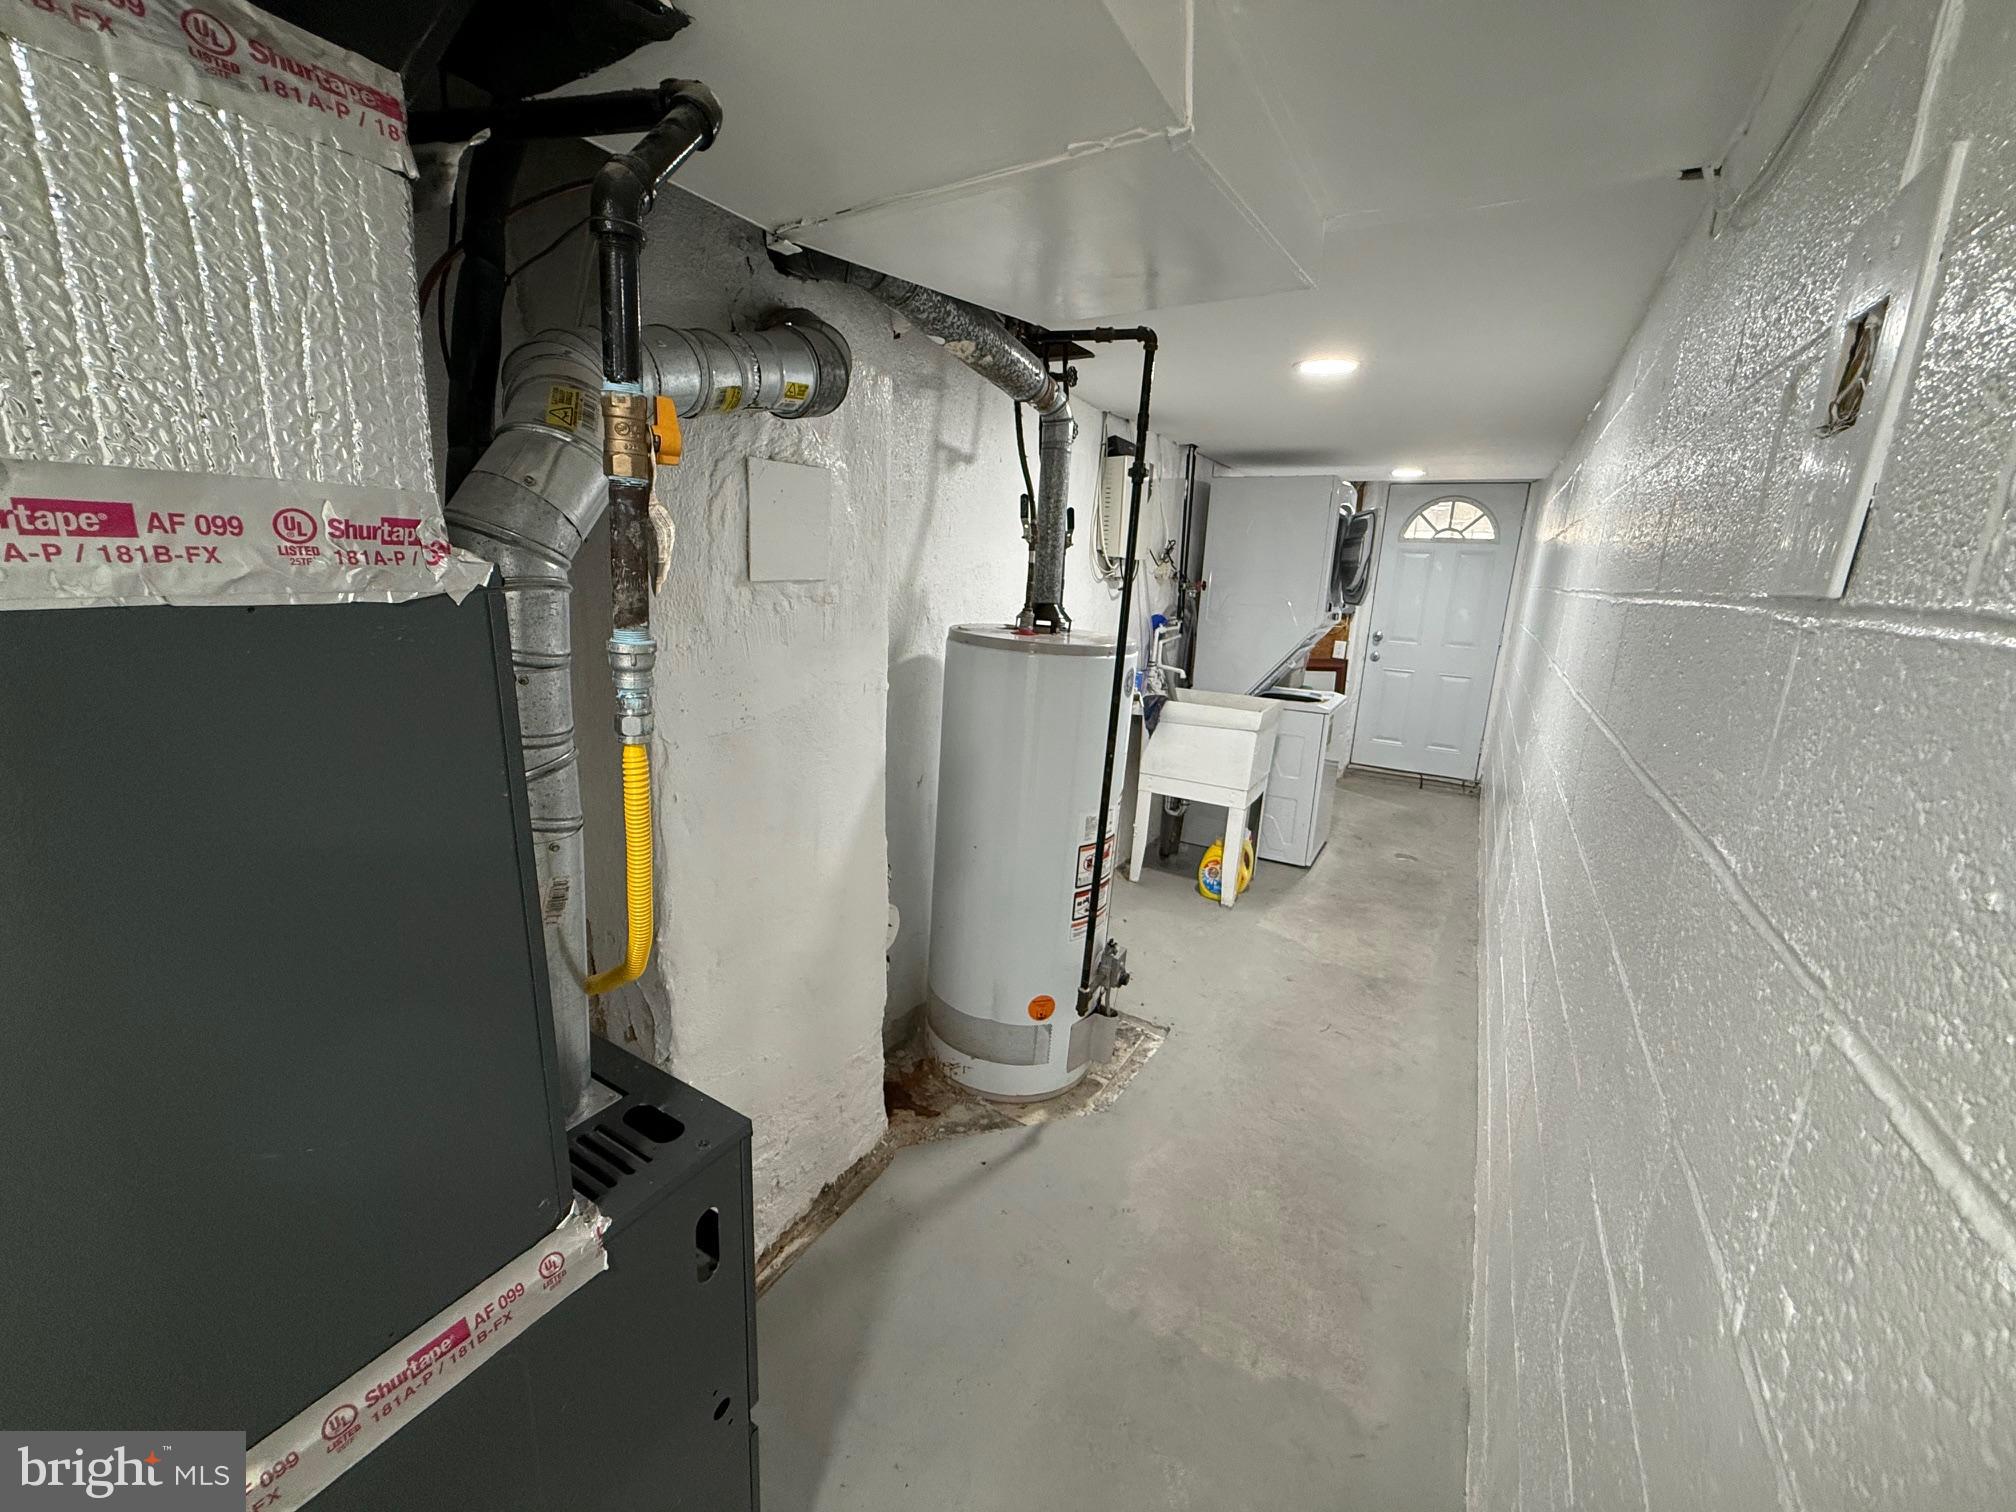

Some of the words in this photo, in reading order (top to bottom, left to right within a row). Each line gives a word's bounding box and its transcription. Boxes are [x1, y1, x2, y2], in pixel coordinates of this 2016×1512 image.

[188, 45, 241, 75] LISTED
[258, 75, 350, 119] 181A-P
[147, 511, 186, 535] AF
[194, 513, 244, 537] 099
[97, 545, 223, 564] 181B-FX
[277, 545, 321, 557] LISTED
[334, 551, 406, 566] 181A-P
[365, 1337, 456, 1408] Shurtape
[474, 1303, 496, 1329] AF
[498, 1282, 525, 1310] 099
[371, 1371, 433, 1423] 181A-P
[450, 1311, 514, 1364] 181B-FX
[260, 1451, 299, 1488] 099
